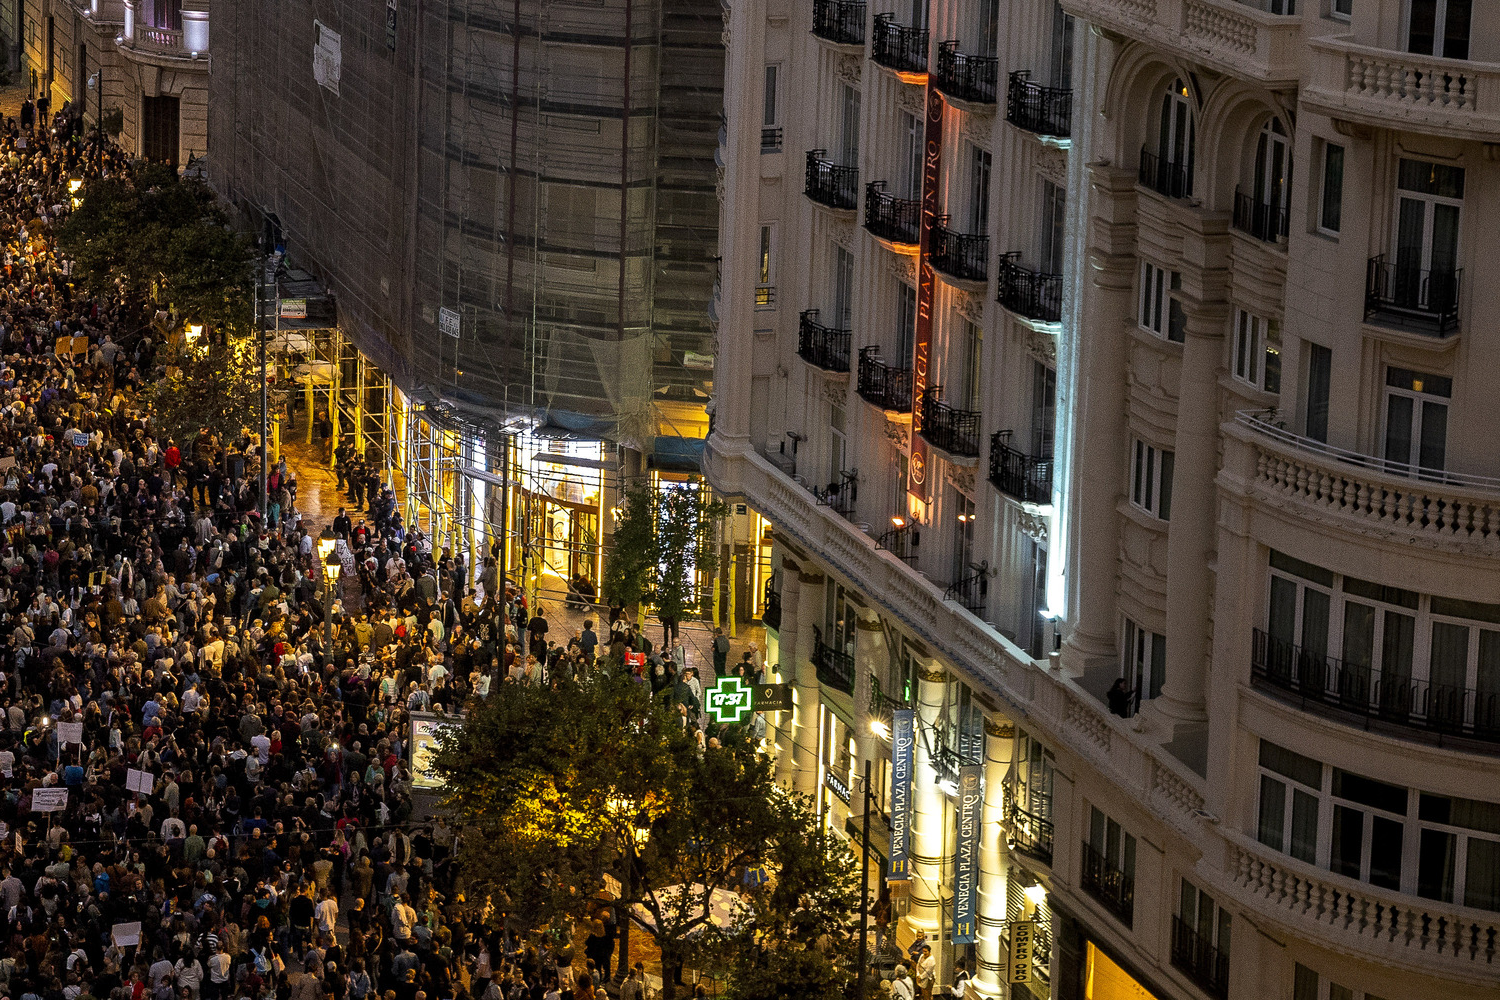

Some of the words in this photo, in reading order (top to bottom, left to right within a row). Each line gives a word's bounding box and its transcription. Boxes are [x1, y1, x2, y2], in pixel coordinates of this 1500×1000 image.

[896, 737, 912, 779] CENTRO
[894, 781, 906, 812] PLAZA
[962, 794, 979, 838] CENTRO
[892, 815, 905, 857] VENECIA
[960, 840, 971, 871] PLAZA
[958, 874, 970, 919] VENECIA
[1015, 925, 1028, 959] COMPRO
[1015, 964, 1027, 980] ORO
